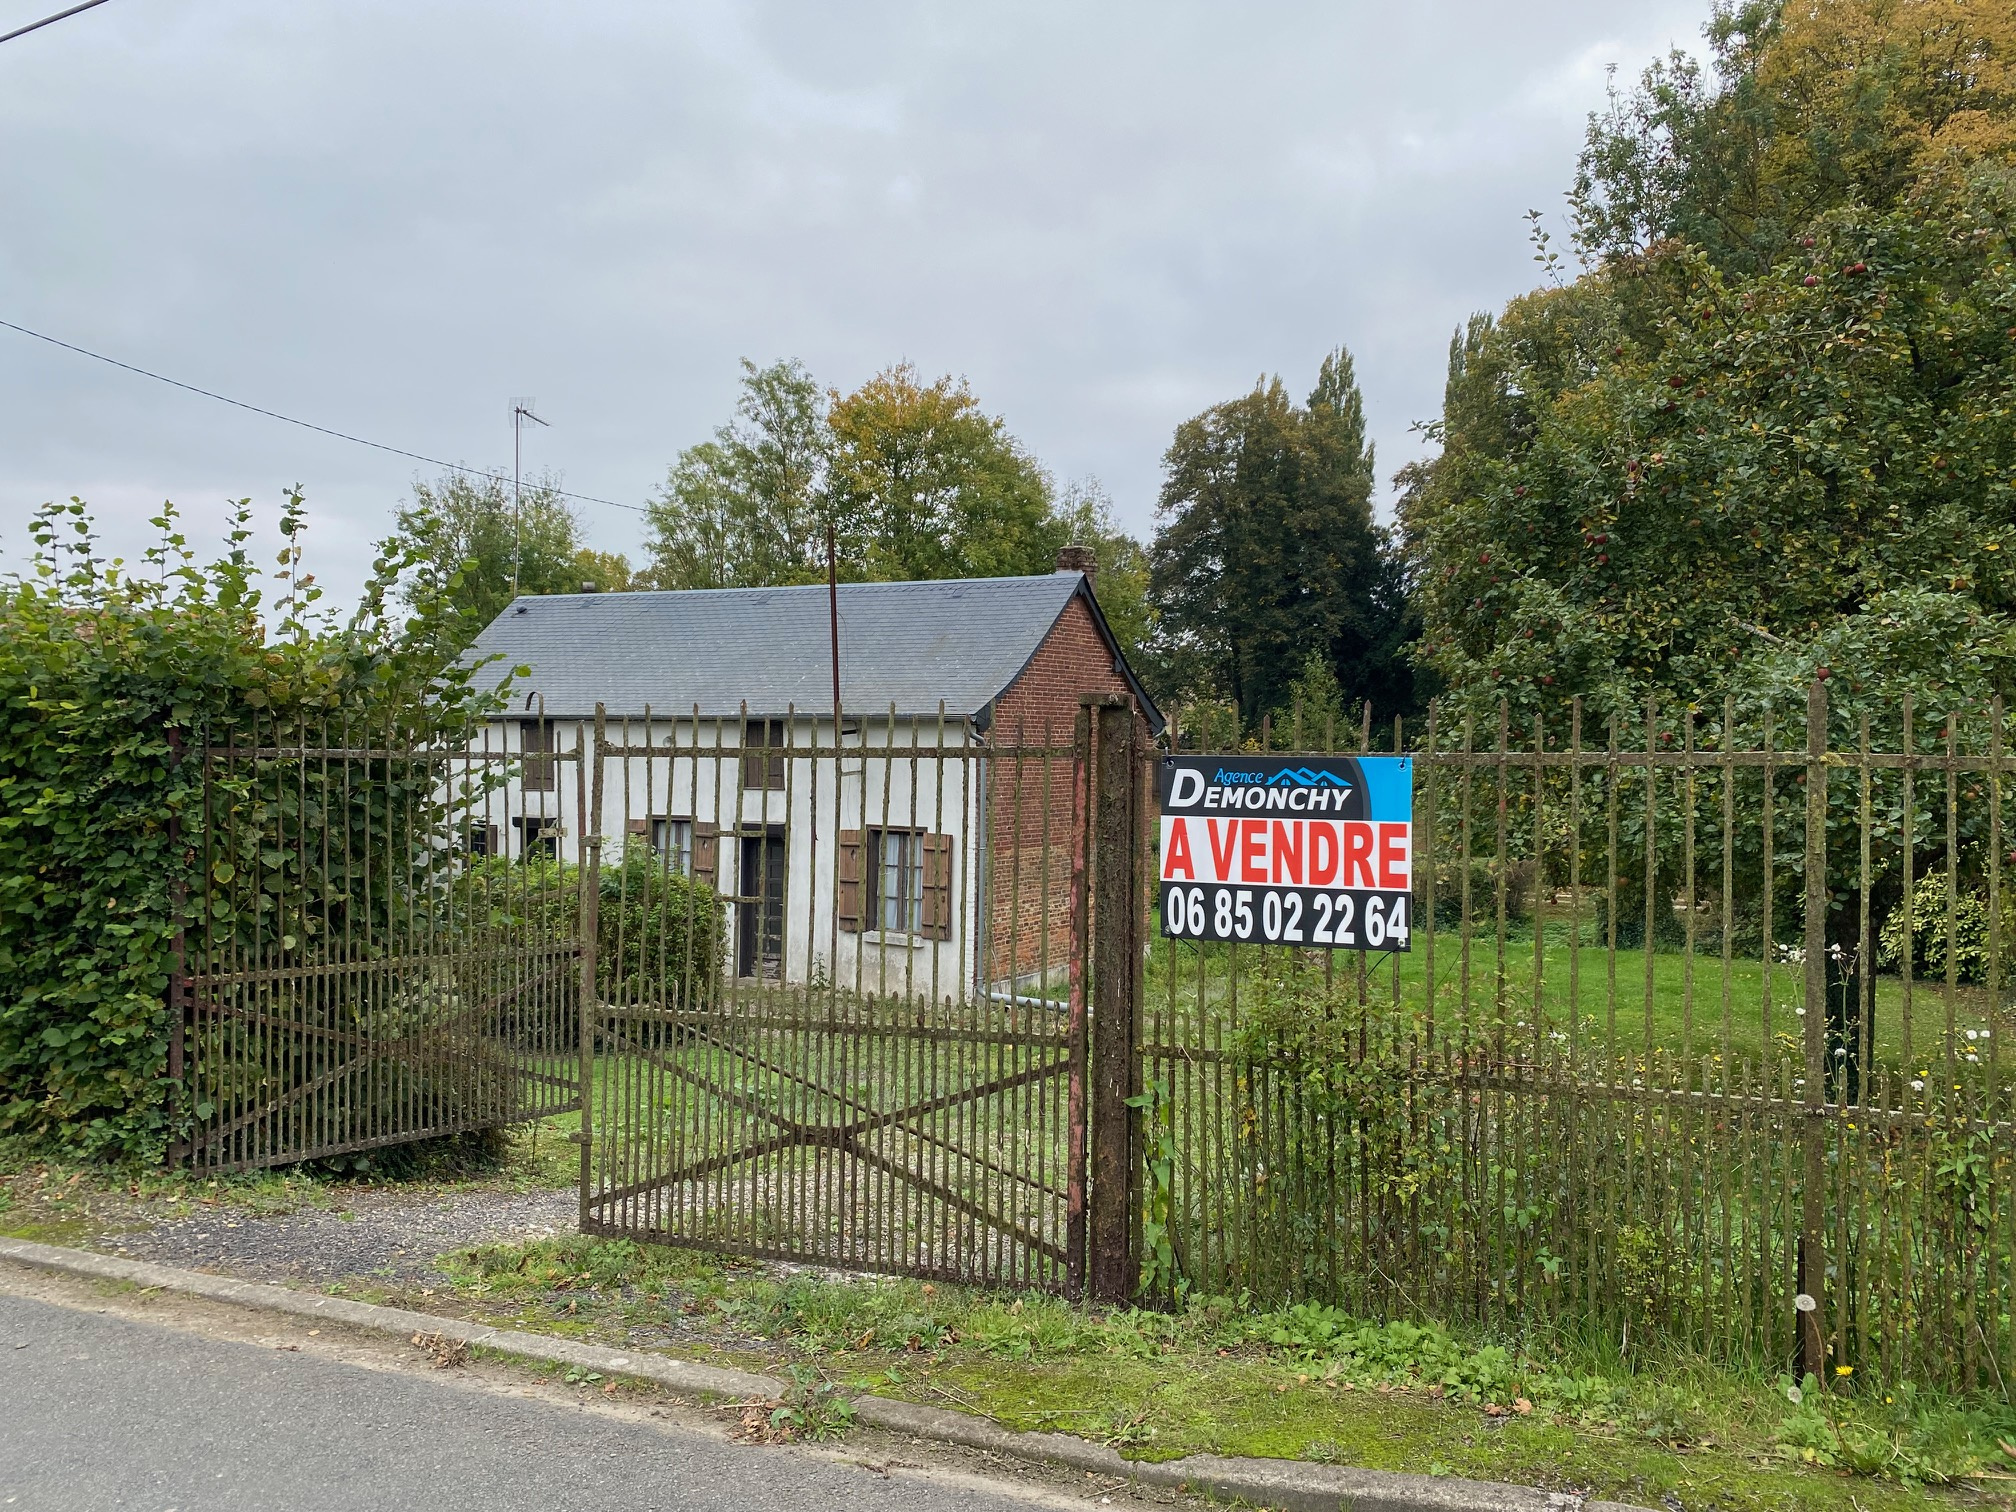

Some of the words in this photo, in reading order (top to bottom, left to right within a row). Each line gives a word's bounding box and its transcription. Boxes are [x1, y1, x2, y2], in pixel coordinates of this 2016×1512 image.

[1214, 767, 1264, 786] Agence
[1163, 817, 1195, 880] A
[1206, 818, 1408, 890] VENDRE
[1167, 886, 1206, 936] 06
[1214, 888, 1254, 939] 85
[1262, 890, 1303, 942] 02
[1312, 892, 1355, 945] 22
[1365, 895, 1408, 946] 64
